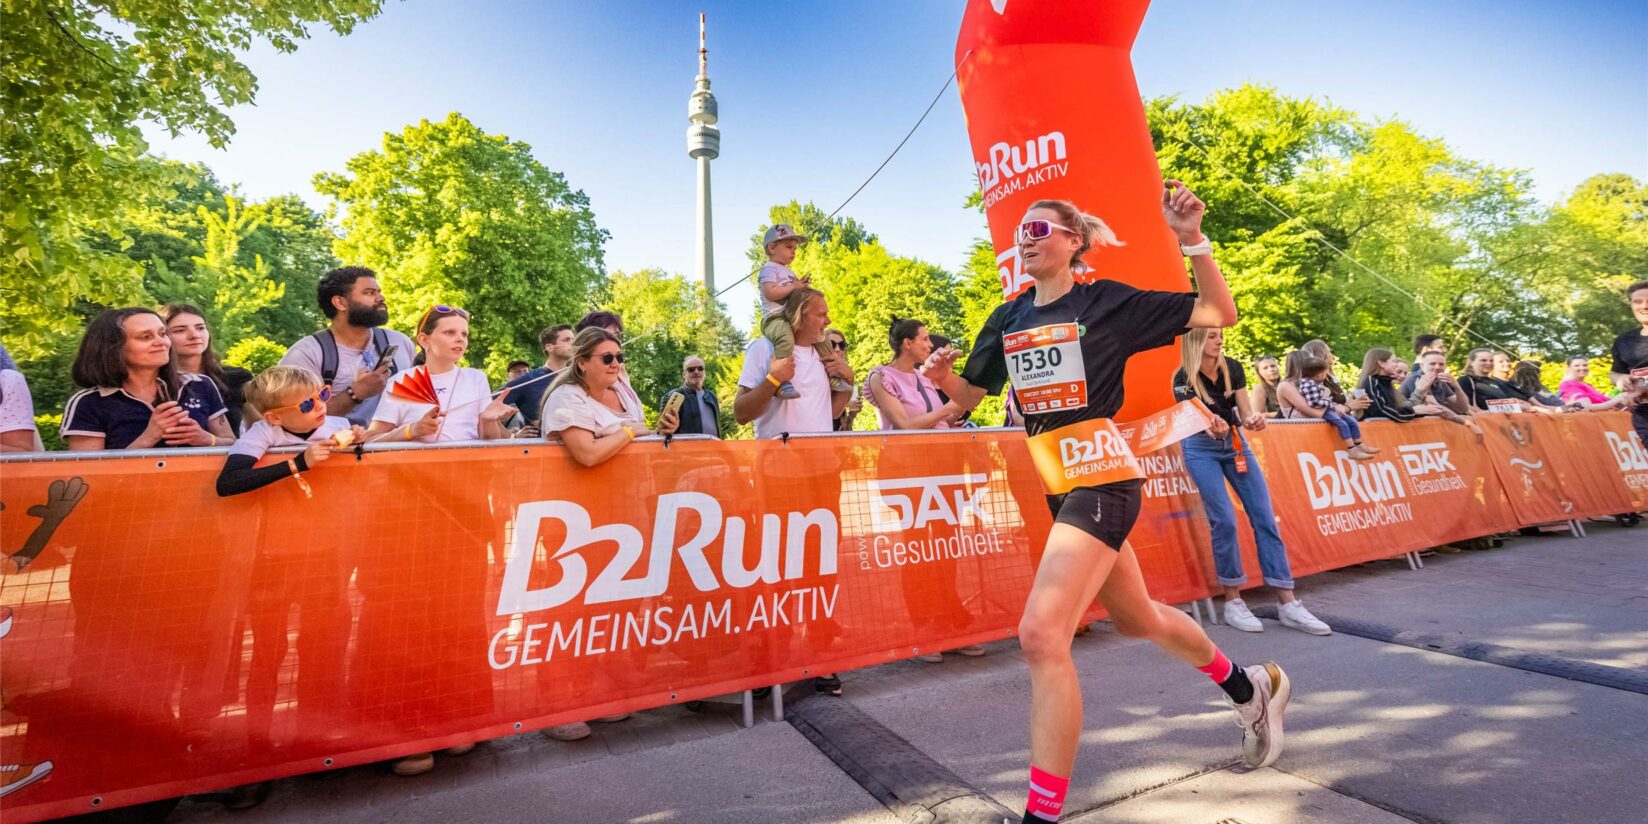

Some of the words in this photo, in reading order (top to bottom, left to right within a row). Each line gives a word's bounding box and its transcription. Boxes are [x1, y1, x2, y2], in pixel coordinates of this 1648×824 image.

[1026, 161, 1069, 188] AKTIV
[1011, 346, 1062, 374] 7530
[1021, 370, 1055, 381] ALEXANDRA
[1070, 384, 1078, 393] D
[1060, 430, 1130, 467] B2Ru
[1398, 442, 1457, 475] DAK
[1136, 455, 1184, 475] INSAM
[1297, 450, 1406, 510] B2Run
[1143, 476, 1200, 498] VIELFAL
[1411, 472, 1468, 495] Gesundheit
[867, 473, 996, 533] DAK
[496, 491, 839, 617] B2Run
[873, 528, 1003, 568] Gesundheit
[488, 601, 741, 670] GEMEINSAM.
[746, 584, 840, 632] AKTIV
